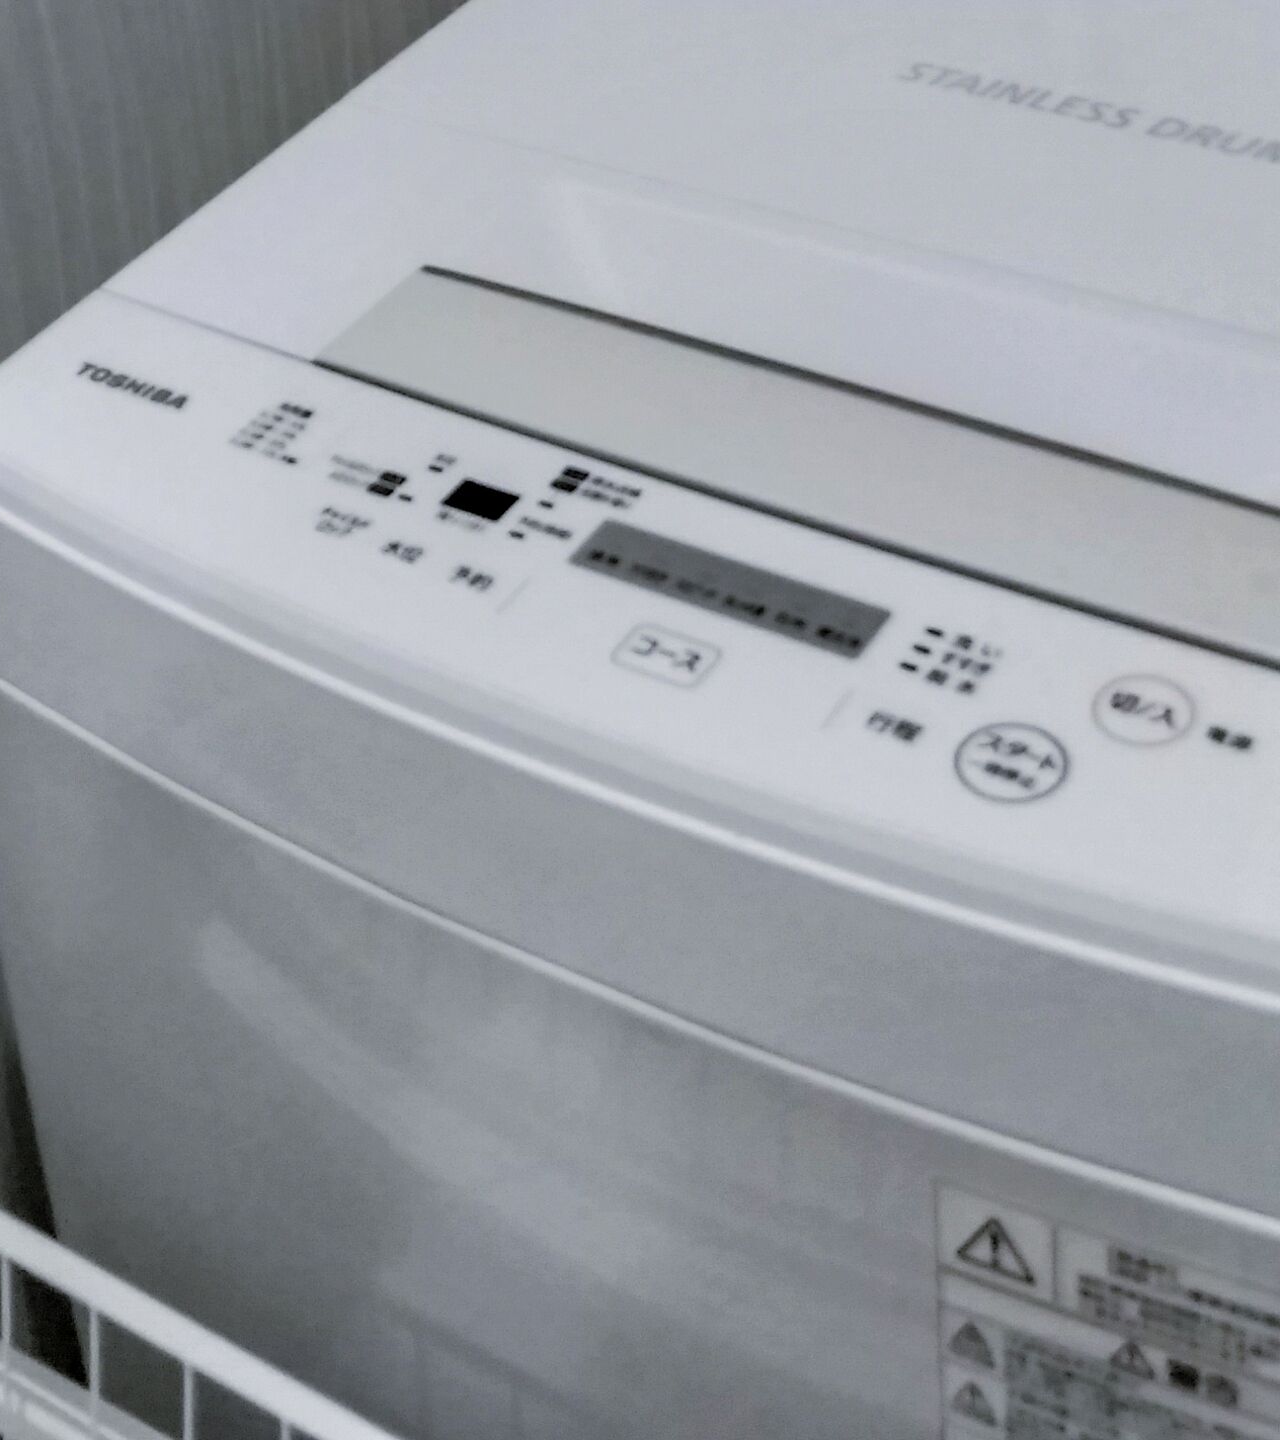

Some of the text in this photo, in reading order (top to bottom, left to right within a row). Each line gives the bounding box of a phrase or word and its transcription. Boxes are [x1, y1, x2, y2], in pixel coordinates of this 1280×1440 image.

[899, 62, 1141, 130] STAINLESS
[76, 361, 189, 410] TOSHIBA
[630, 633, 703, 674] コース
[977, 731, 1057, 771] スタート
